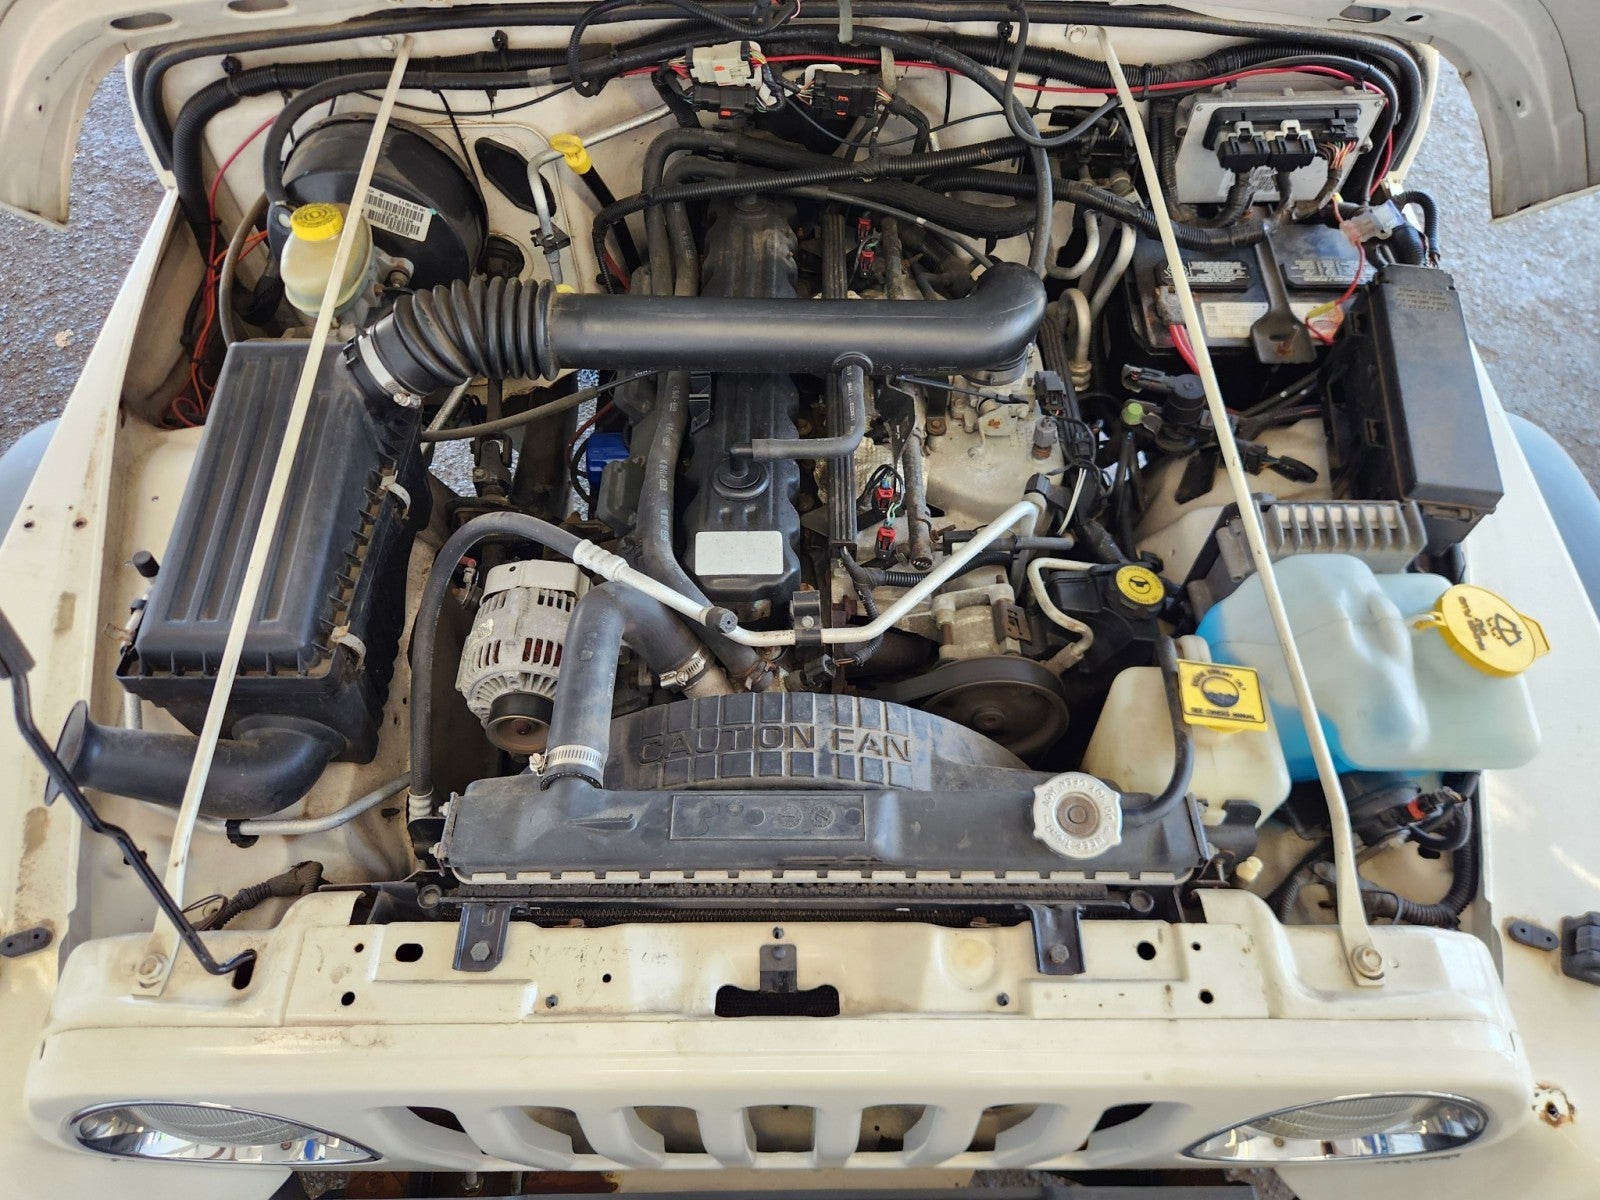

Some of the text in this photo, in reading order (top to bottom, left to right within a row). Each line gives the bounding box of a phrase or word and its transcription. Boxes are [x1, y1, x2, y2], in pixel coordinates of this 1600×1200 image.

[638, 725, 912, 765] CAUTION FAN
[1058, 778, 1087, 788] OPEN
